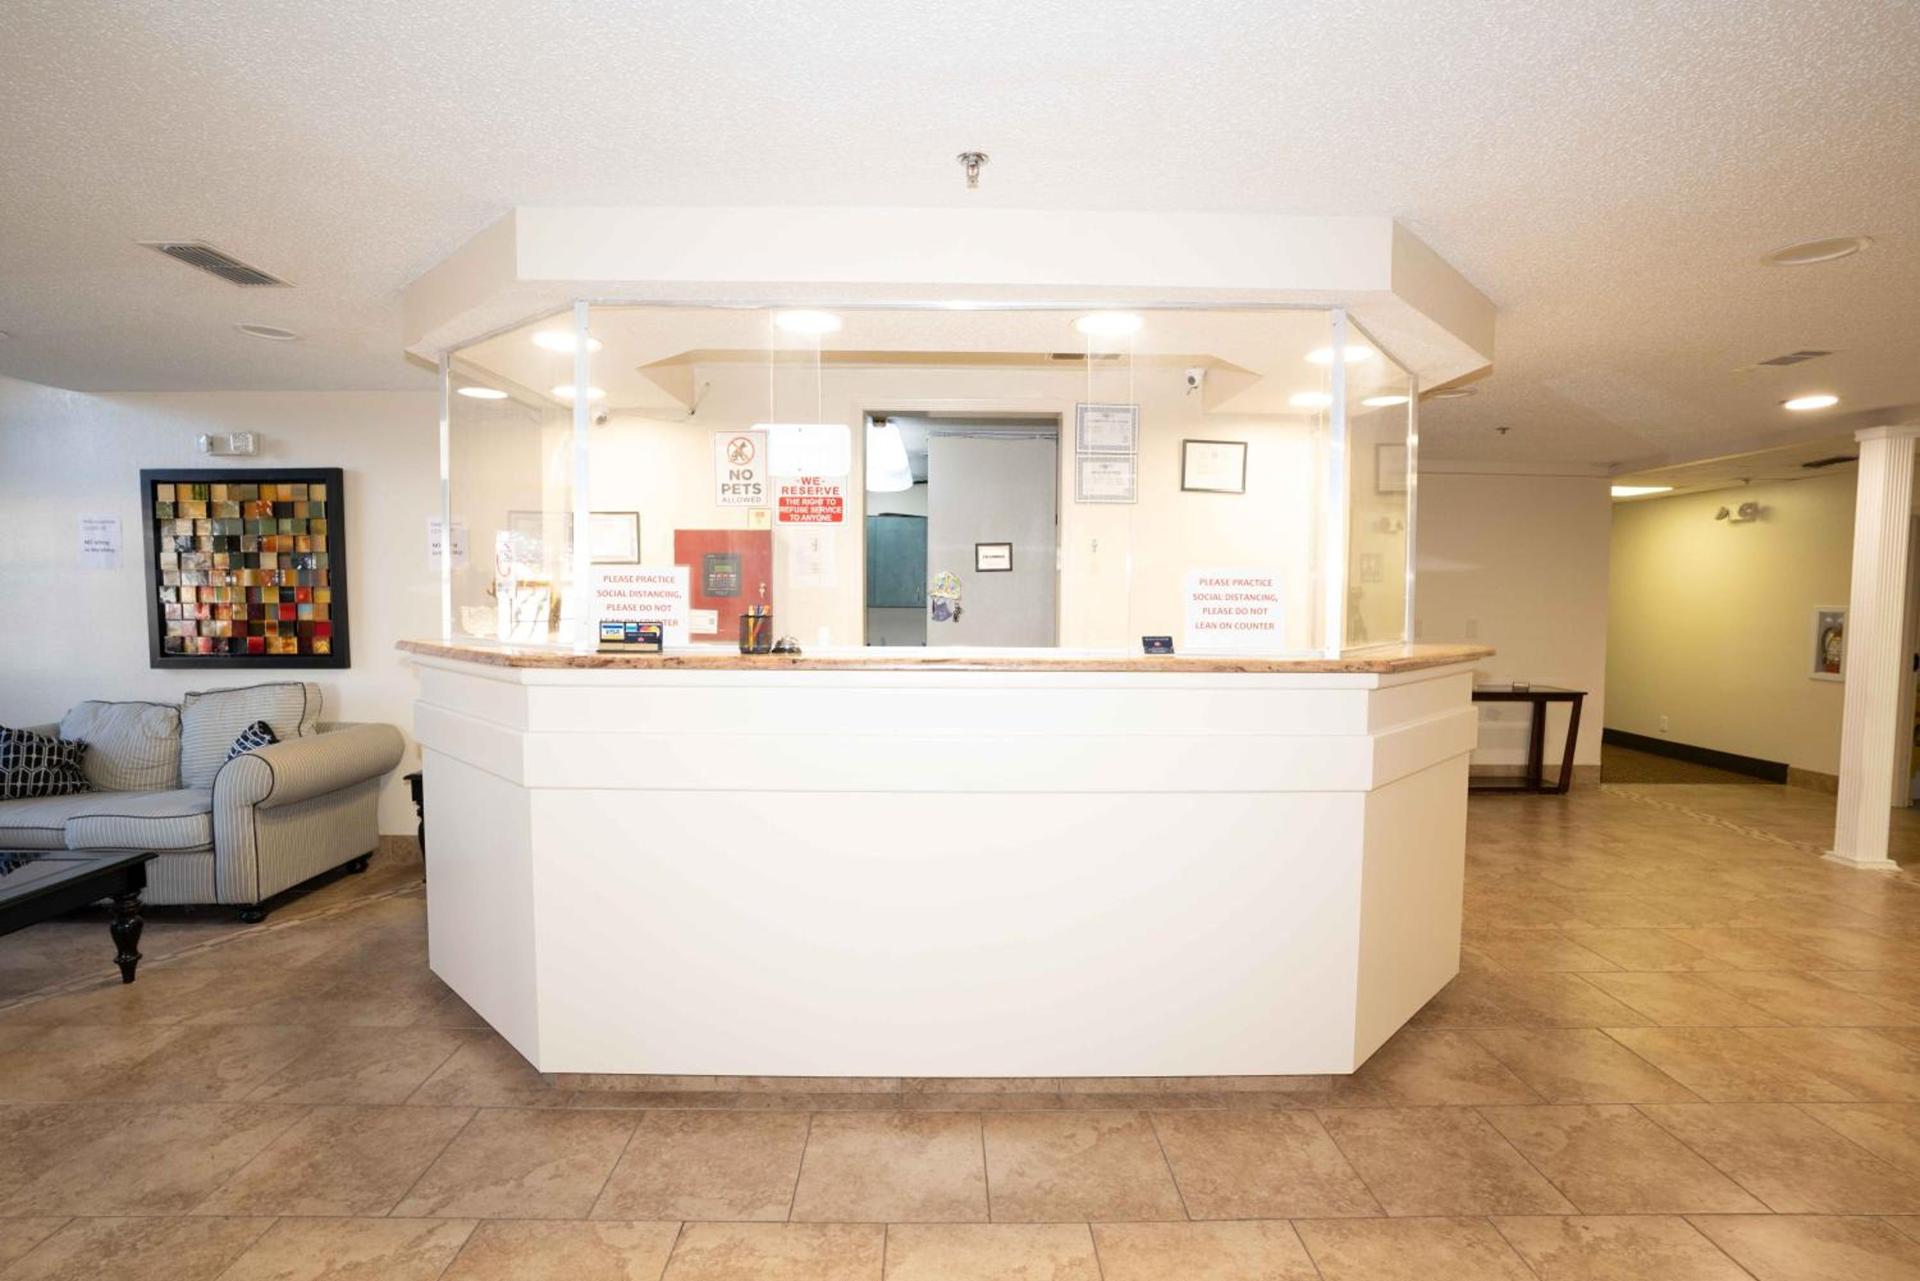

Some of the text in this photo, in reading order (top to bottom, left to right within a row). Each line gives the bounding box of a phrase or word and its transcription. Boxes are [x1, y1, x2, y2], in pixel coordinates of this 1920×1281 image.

[729, 469, 753, 480] NO
[801, 476, 821, 485] WE
[721, 482, 762, 495] PETS
[781, 486, 840, 495] RESERVE
[721, 496, 762, 504] ALLOWED
[603, 575, 675, 583] PLEASE PRACTICE
[1199, 578, 1272, 587] PLEASE PRACTICE
[596, 589, 682, 599] SOCIAL DISTANCING,
[1193, 593, 1278, 602] SOCIAL DISTANCING,
[606, 603, 672, 612] PLEASE DO NOT
[1202, 607, 1268, 615] PLEASE DO NOT
[1195, 621, 1275, 630] LEAN ON COUNTER
